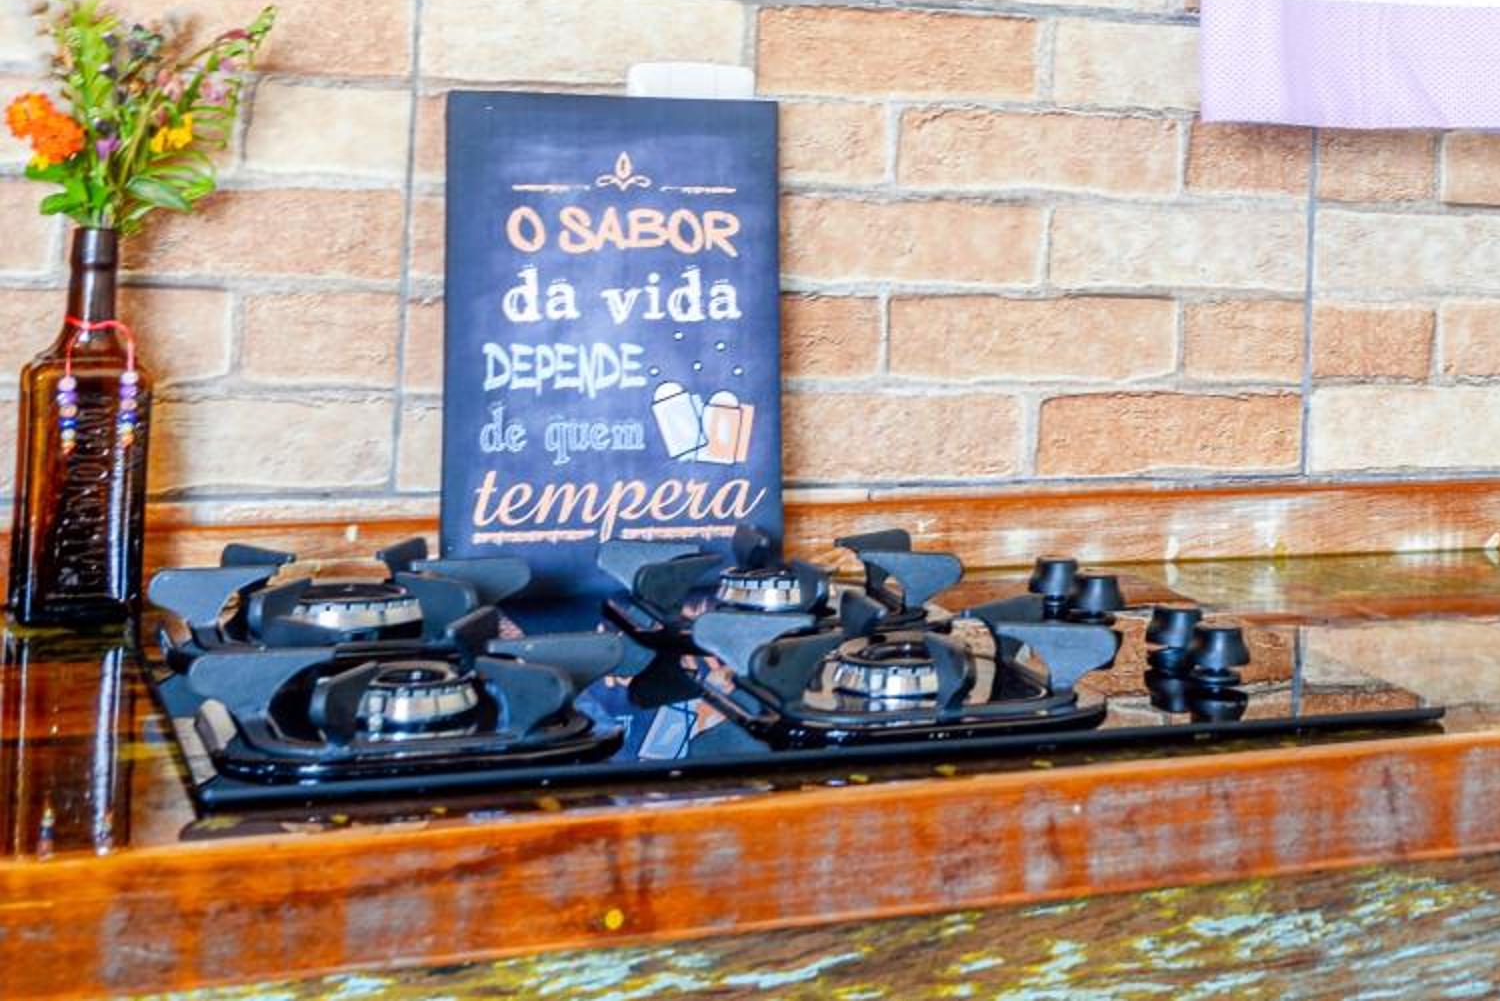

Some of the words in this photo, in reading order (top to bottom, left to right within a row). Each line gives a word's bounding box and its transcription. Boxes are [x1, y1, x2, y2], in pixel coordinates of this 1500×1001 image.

[505, 205, 547, 253] O
[557, 205, 742, 258] SABOR
[502, 264, 581, 323] da
[599, 264, 743, 324] vida
[482, 341, 649, 399] DEPENDE
[479, 402, 528, 453] de
[544, 413, 645, 466] quem
[470, 469, 768, 543] tempera
